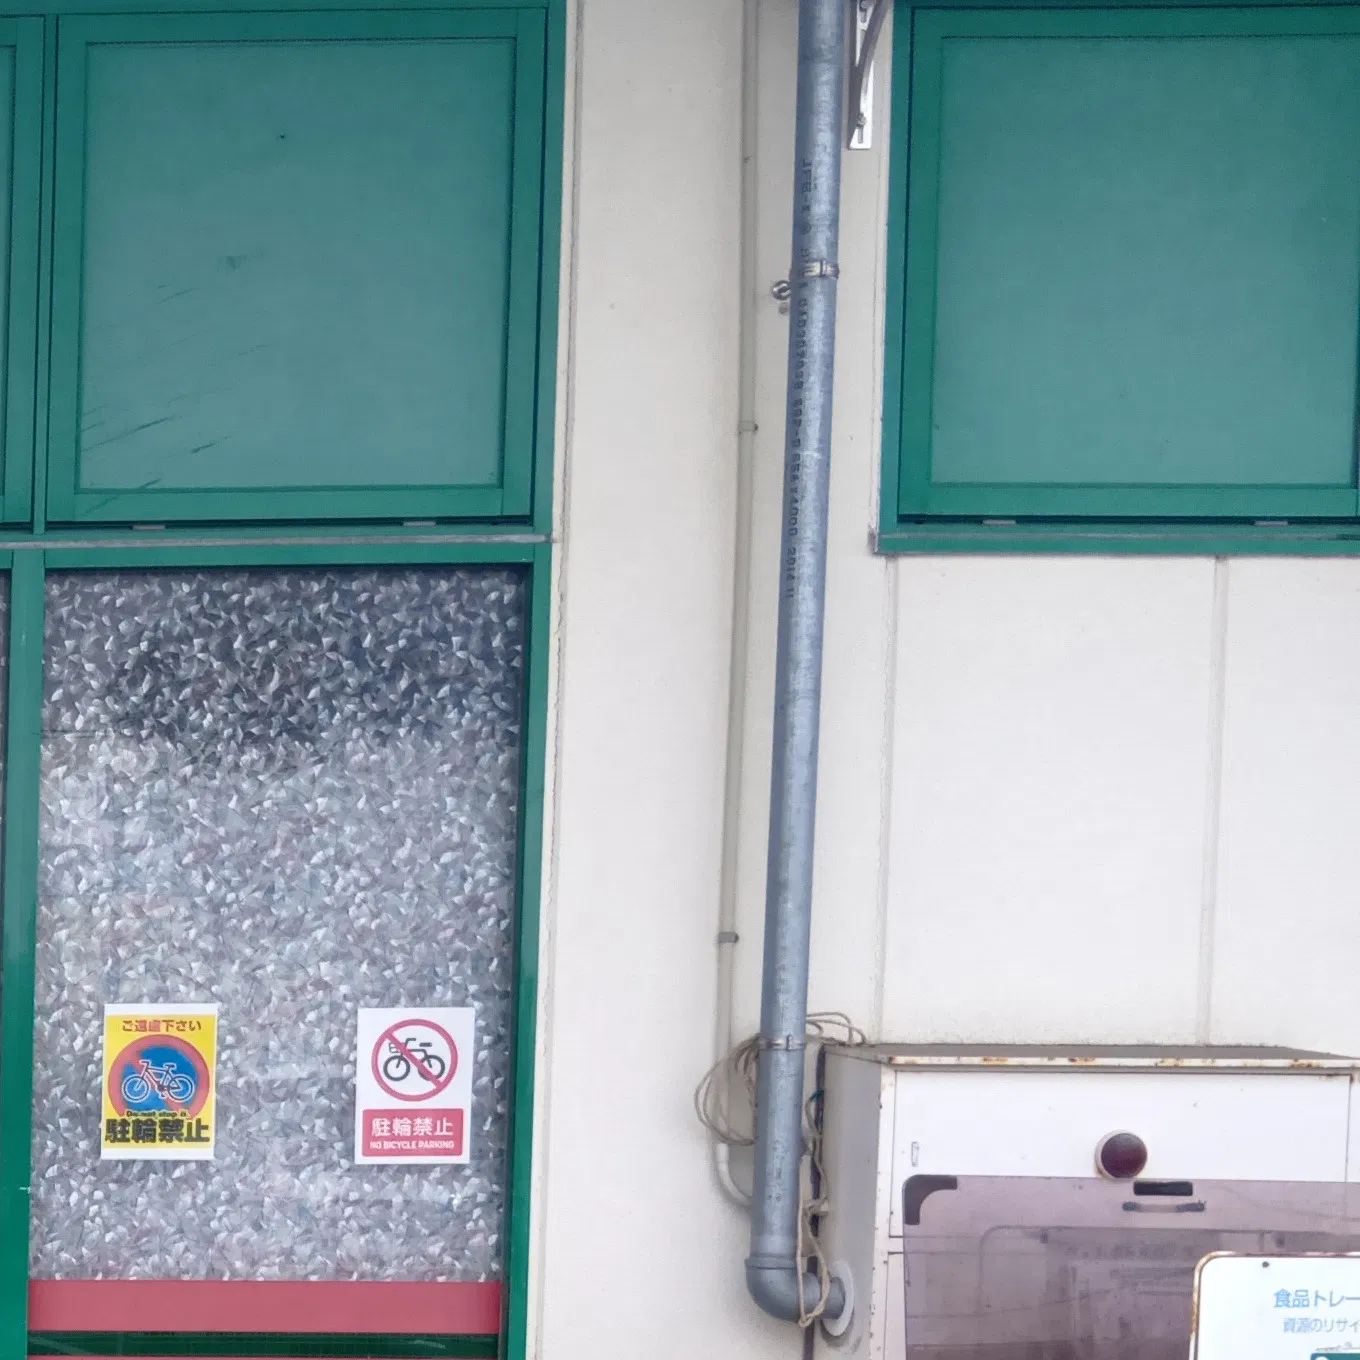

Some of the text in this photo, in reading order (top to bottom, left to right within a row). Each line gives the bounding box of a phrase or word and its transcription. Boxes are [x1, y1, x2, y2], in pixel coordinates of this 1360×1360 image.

[122, 1020, 202, 1032] ご遠慮下さい
[105, 1118, 210, 1143] 駐輪禁止
[371, 1117, 454, 1136] 駐輪禁止
[370, 1141, 381, 1149] NO
[1274, 1289, 1360, 1308] 食品トレー
